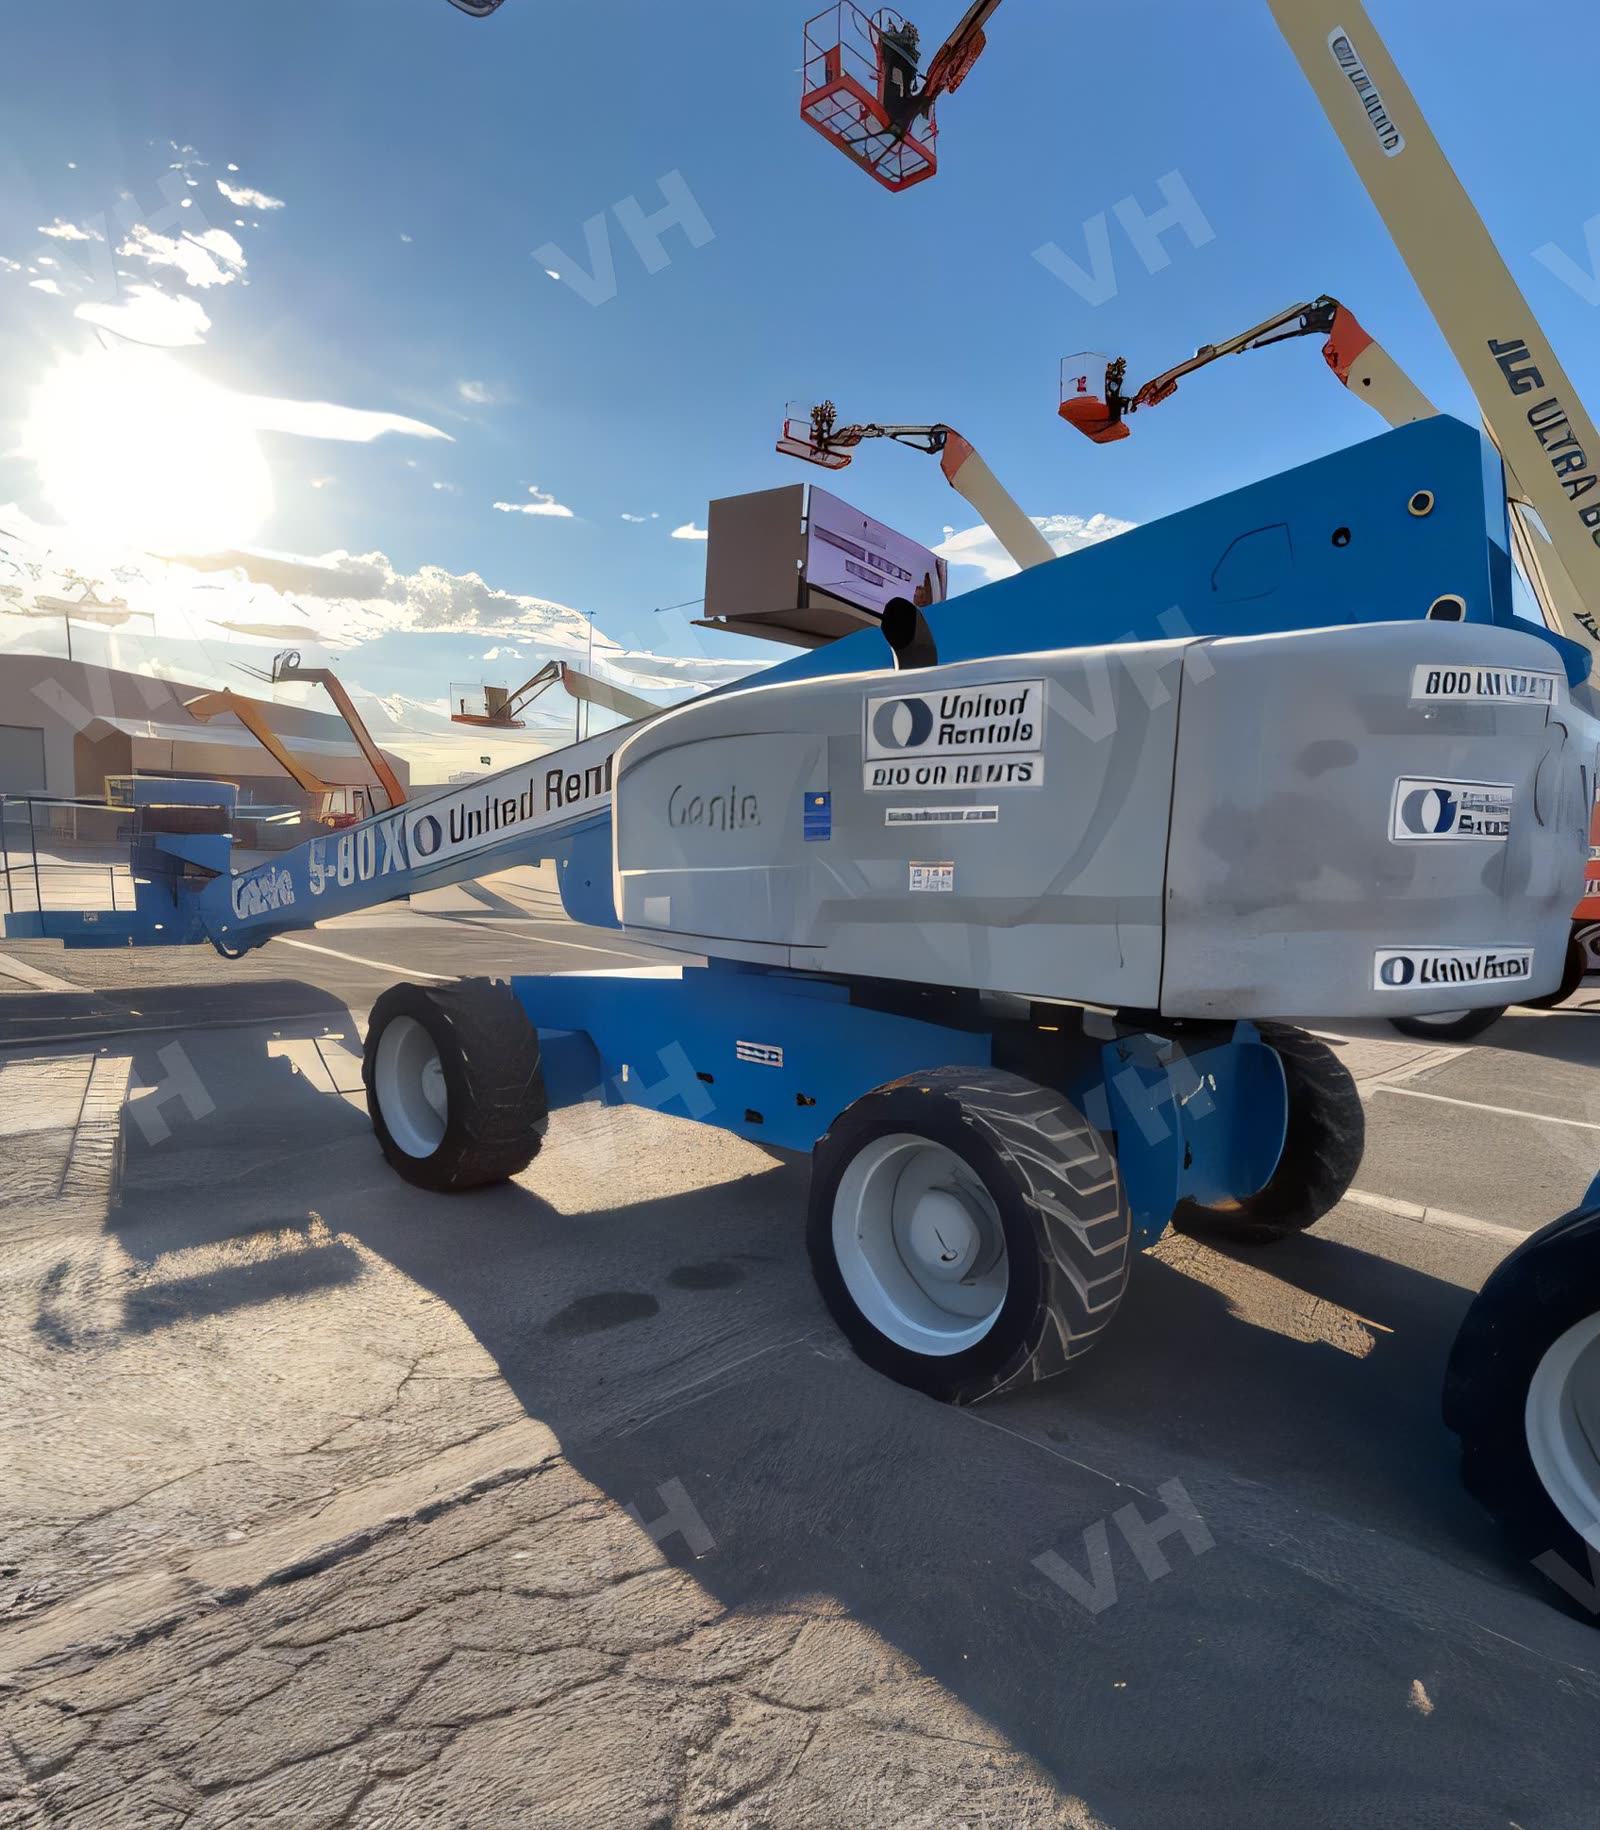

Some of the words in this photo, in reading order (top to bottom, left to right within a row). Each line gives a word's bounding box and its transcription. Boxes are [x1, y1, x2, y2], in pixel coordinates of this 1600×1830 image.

[1487, 338, 1545, 395] JLG
[1527, 397, 1598, 501] ULTRA
[449, 778, 534, 844] United
